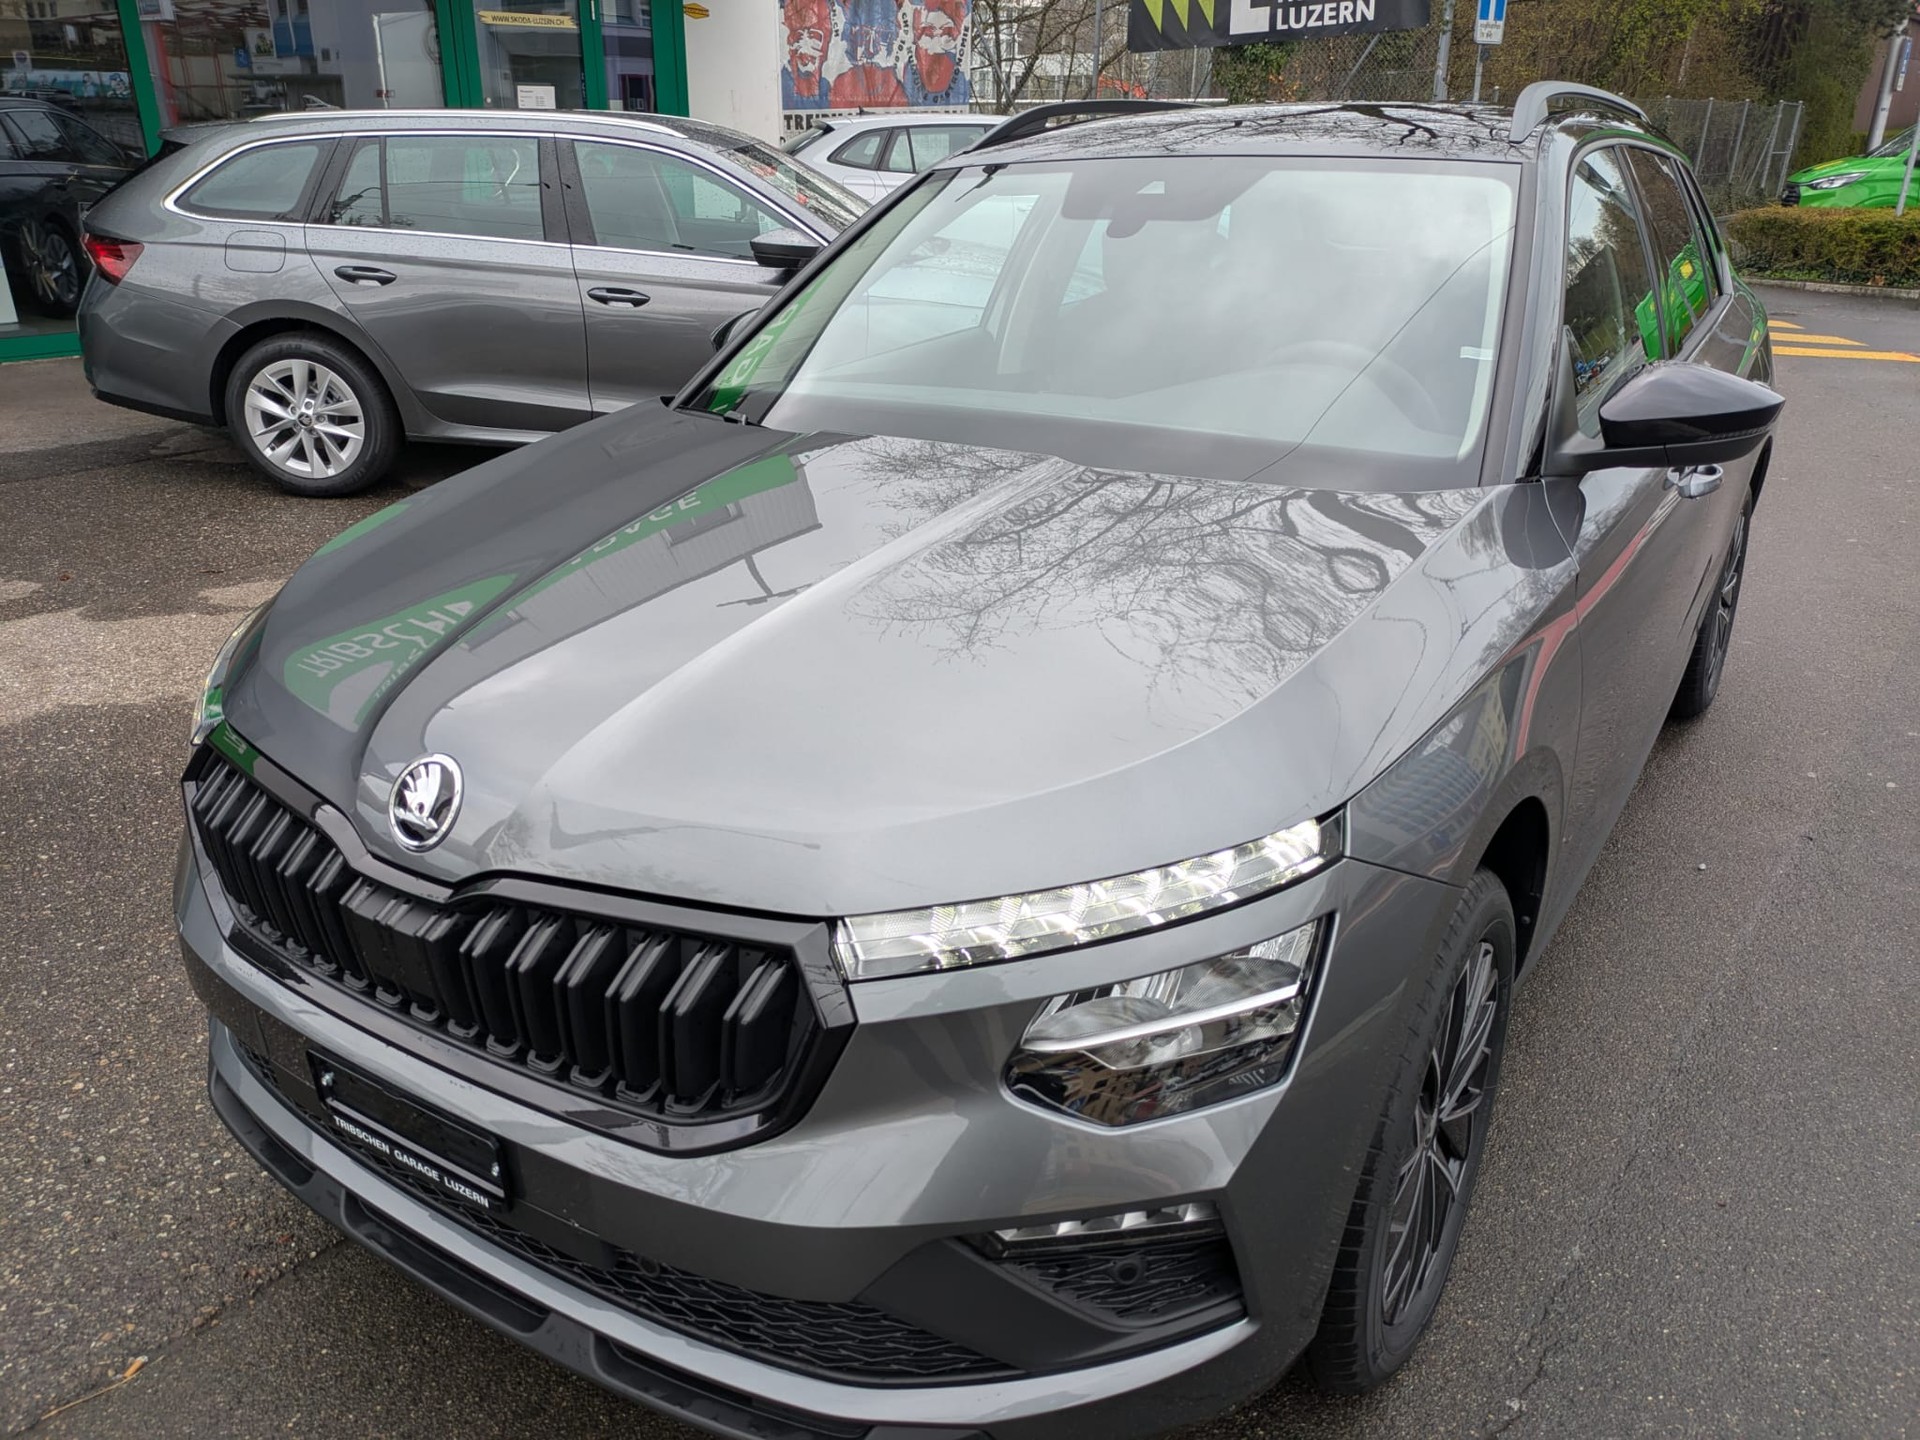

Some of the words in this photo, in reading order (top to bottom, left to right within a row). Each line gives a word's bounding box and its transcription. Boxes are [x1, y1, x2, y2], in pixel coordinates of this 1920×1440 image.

[1276, 0, 1376, 30] LUZERN
[333, 1115, 390, 1155] TRIBSCHEN
[394, 1150, 441, 1182] GARAGE
[444, 1176, 489, 1208] LUZERN
